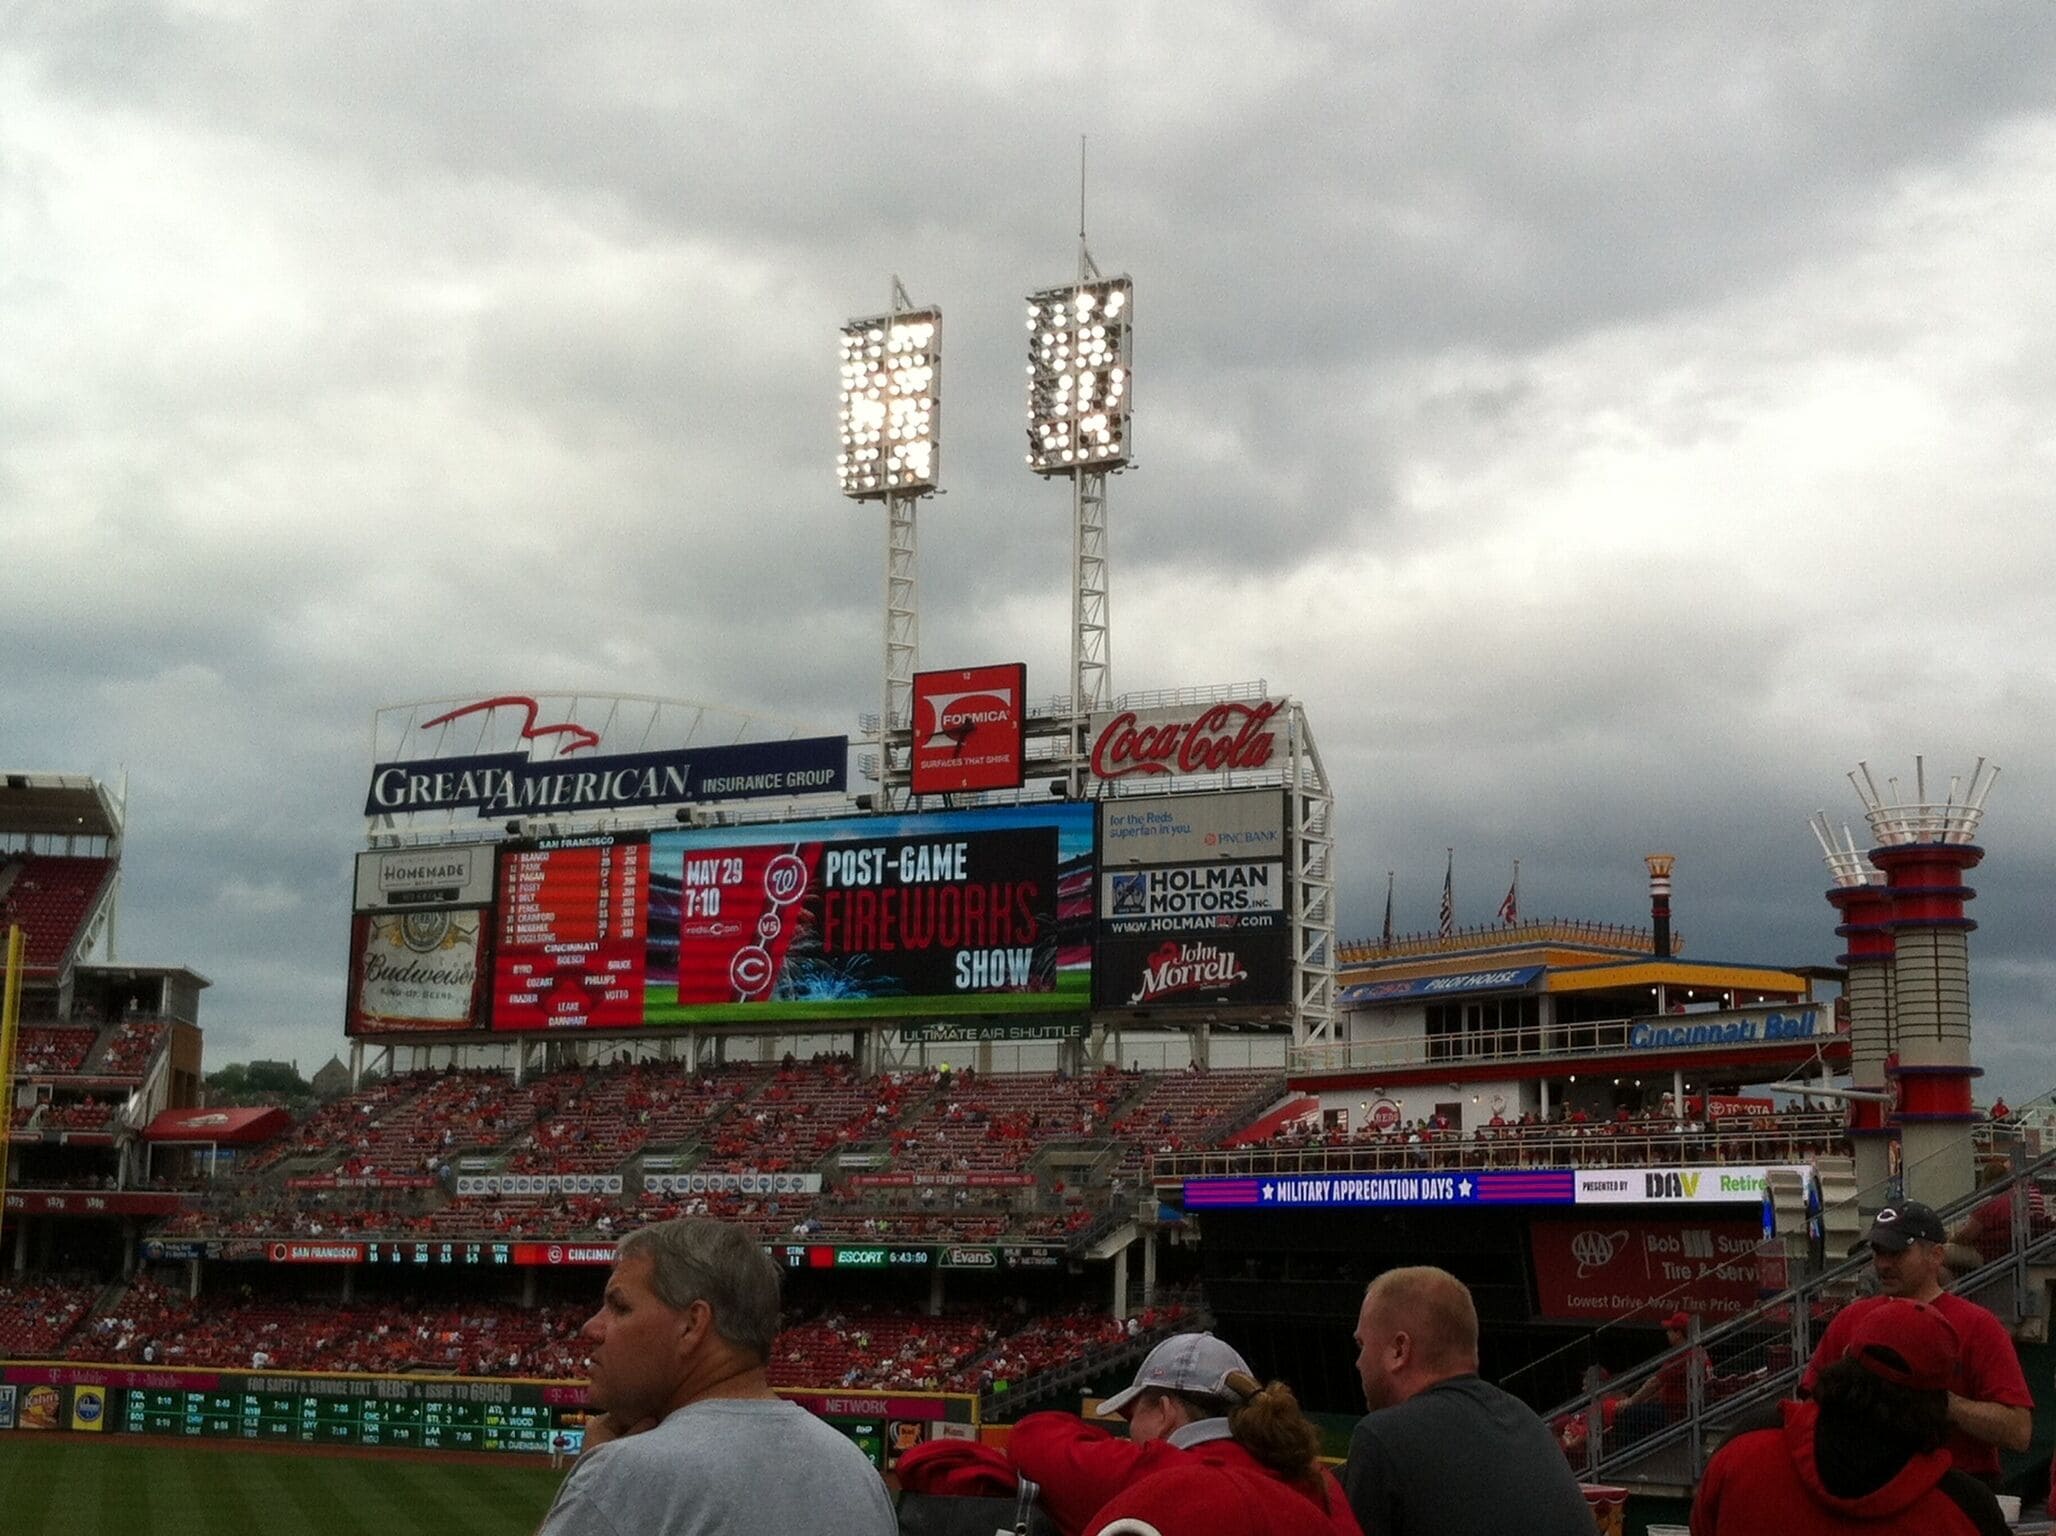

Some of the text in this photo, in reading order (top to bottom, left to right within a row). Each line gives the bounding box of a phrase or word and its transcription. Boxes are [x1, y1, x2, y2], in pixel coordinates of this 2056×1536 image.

[943, 710, 1008, 726] FORMICA
[1092, 698, 1288, 779] Coca-Cola
[921, 757, 963, 770] SURFACES
[964, 755, 985, 766] THAT
[375, 763, 690, 810] GREAT AMERICAN
[703, 769, 835, 793] INSURANCE GROUP
[1110, 811, 1173, 826] for the Reds
[1110, 825, 1157, 839] superfan
[1159, 825, 1169, 835] in
[1245, 830, 1277, 842] BANK
[539, 836, 615, 850] SAN FRANCISCO
[520, 852, 550, 862] BLANCO
[826, 842, 968, 887] POST-GAME
[520, 863, 541, 872] PANIK
[687, 858, 743, 886] MAY 29
[520, 872, 545, 882] PAGAN
[1150, 866, 1268, 892] HOLMAN
[519, 883, 541, 892] POSEY
[519, 893, 536, 902] BELT
[685, 887, 720, 917] 7:10
[823, 880, 1039, 953] FIREWORKS
[544, 943, 599, 953] CINCINNATI
[1174, 942, 1217, 965] John
[513, 960, 632, 974] BYRD BRUCE
[557, 955, 585, 965] BOESCH
[364, 952, 477, 986] Budweiser
[955, 948, 1033, 989] SHOW
[1132, 952, 1248, 1001] Morrell
[526, 975, 616, 988] COZART PHILLIPS
[1424, 976, 1467, 990] PILOT
[1463, 970, 1520, 987] HOUSE
[509, 990, 629, 1003] FRAZIER VOTTO
[558, 1002, 579, 1012] LEAKE
[904, 1024, 1080, 1042] ULTIMATE AIR SHUTTLE
[1631, 1010, 1817, 1049] Cincinnati Bell
[1277, 1178, 1453, 1202] MILITARY APPRECIATION DAYS
[1583, 1181, 1628, 1192] PRESENTED BY
[1646, 1172, 1701, 1198] DAV
[1577, 1235, 1611, 1262] AAA
[1648, 1235, 1680, 1252] Bob
[292, 1247, 310, 1258] SAN
[311, 1247, 358, 1259] FRANCISCO
[568, 1249, 616, 1261] CINCINNA
[838, 1251, 884, 1263] ESCORT
[890, 1252, 927, 1263] 6:43:50
[951, 1249, 992, 1265] Evans
[1662, 1262, 1691, 1279] Tire
[1567, 1294, 1609, 1309] Lowest
[1682, 1297, 1707, 1310] Tire
[248, 1378, 266, 1391] FOR
[267, 1379, 299, 1393] SAFETY
[310, 1380, 347, 1394] SERVICE
[350, 1381, 371, 1396] TEXT
[425, 1384, 453, 1399] ISSUE
[455, 1385, 469, 1399] TO
[826, 1400, 888, 1414] NETWORK
[509, 1417, 533, 1427] WOOD
